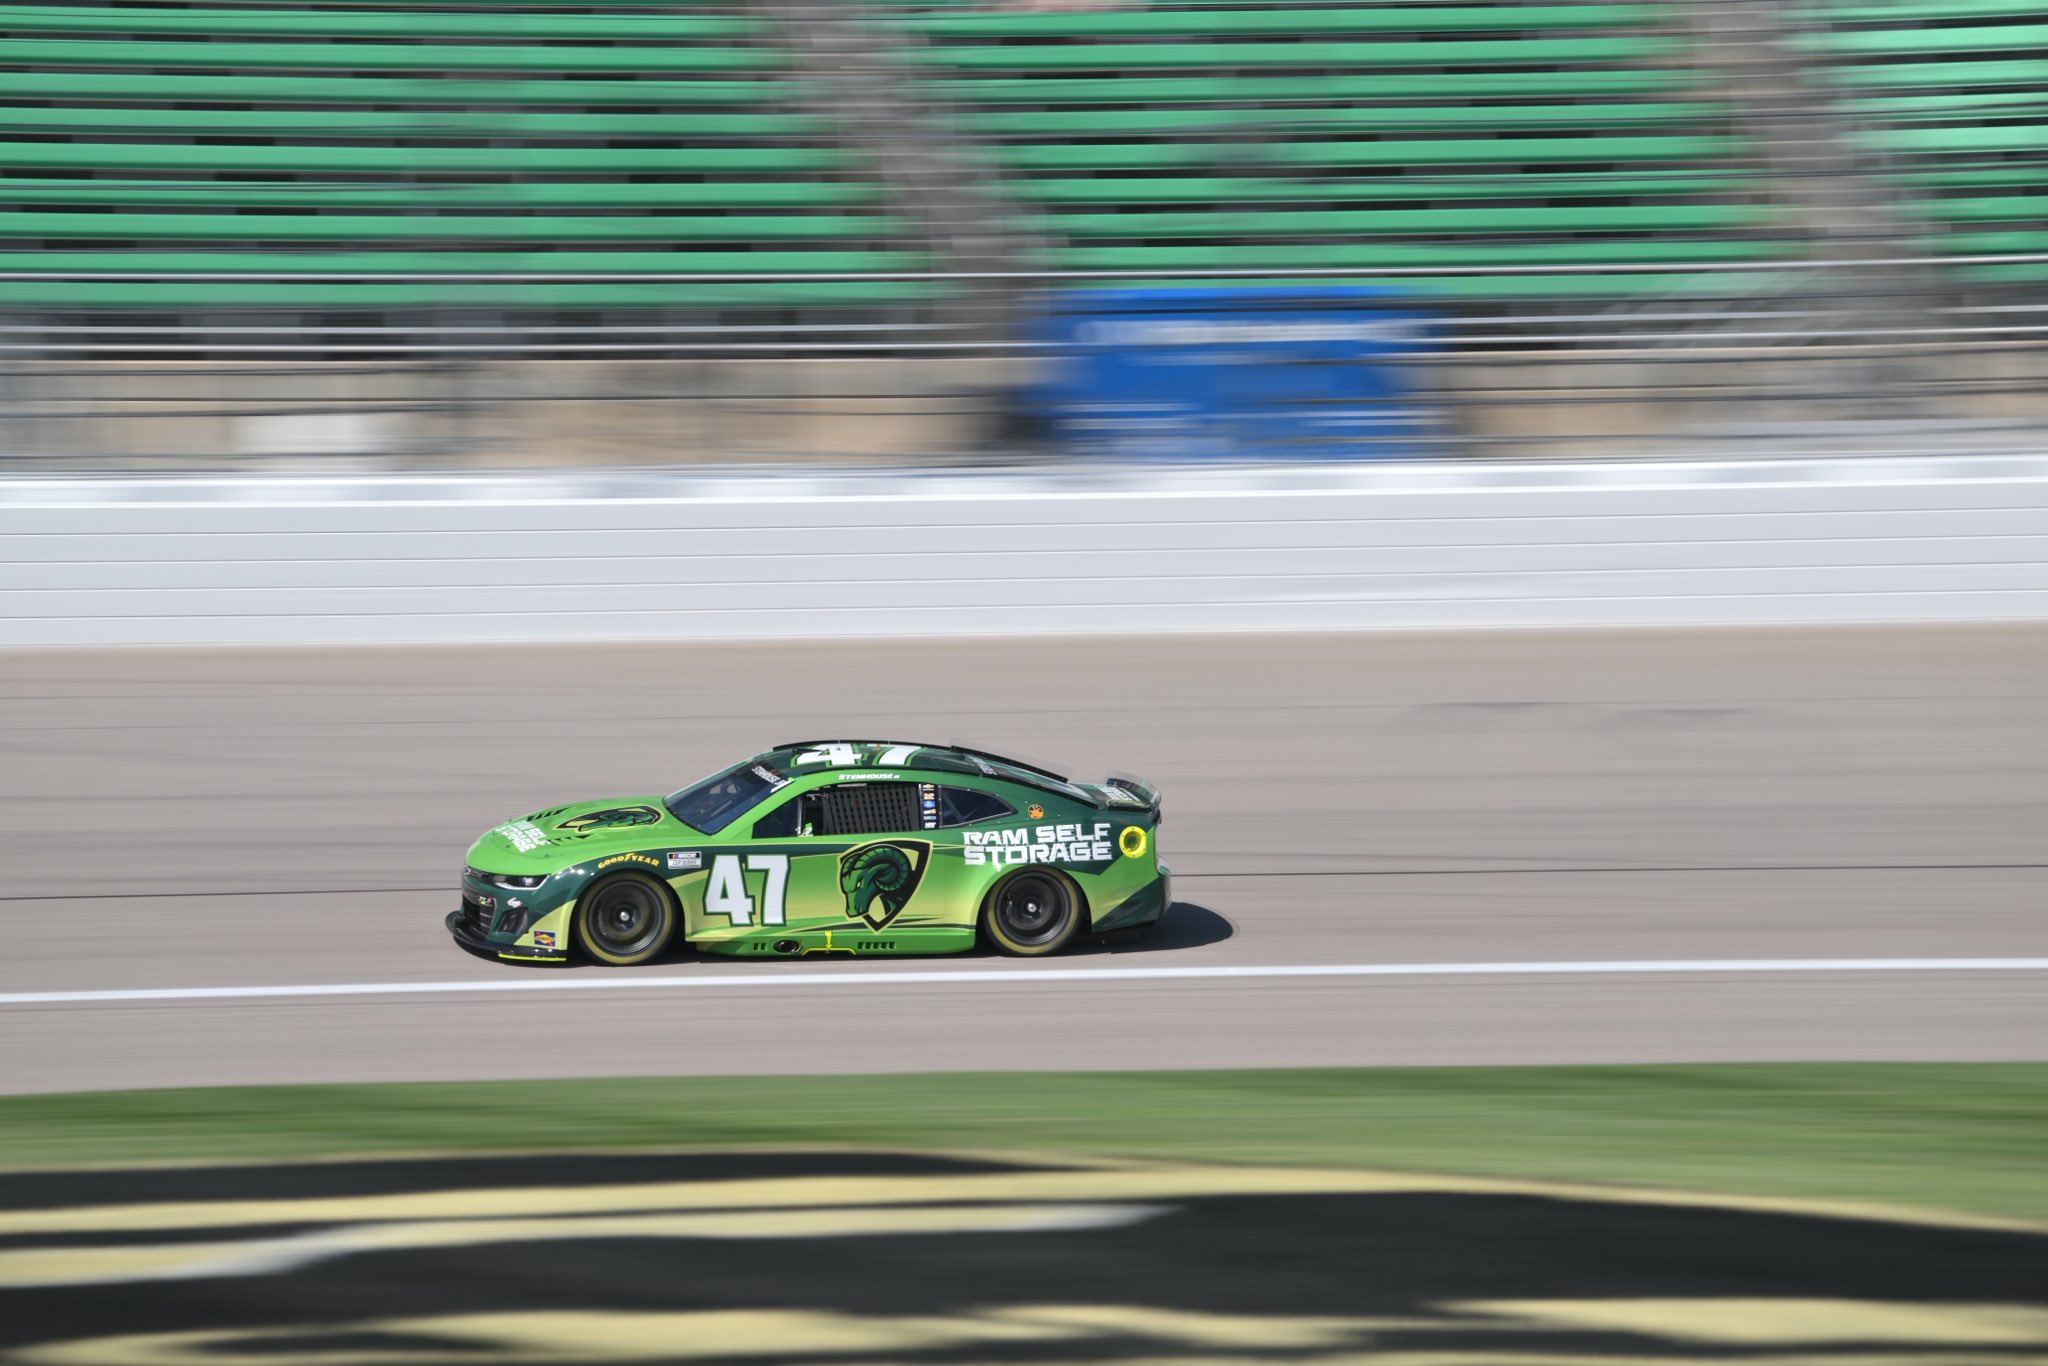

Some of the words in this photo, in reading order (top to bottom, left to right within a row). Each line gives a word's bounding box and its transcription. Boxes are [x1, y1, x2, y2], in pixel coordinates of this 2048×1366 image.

[795, 743, 922, 766] 47
[962, 828, 1028, 845] RAM
[1035, 823, 1112, 843] SELF
[598, 852, 660, 869] GOODYEAR
[964, 841, 1112, 871] STORAGE
[703, 854, 790, 926] 47
